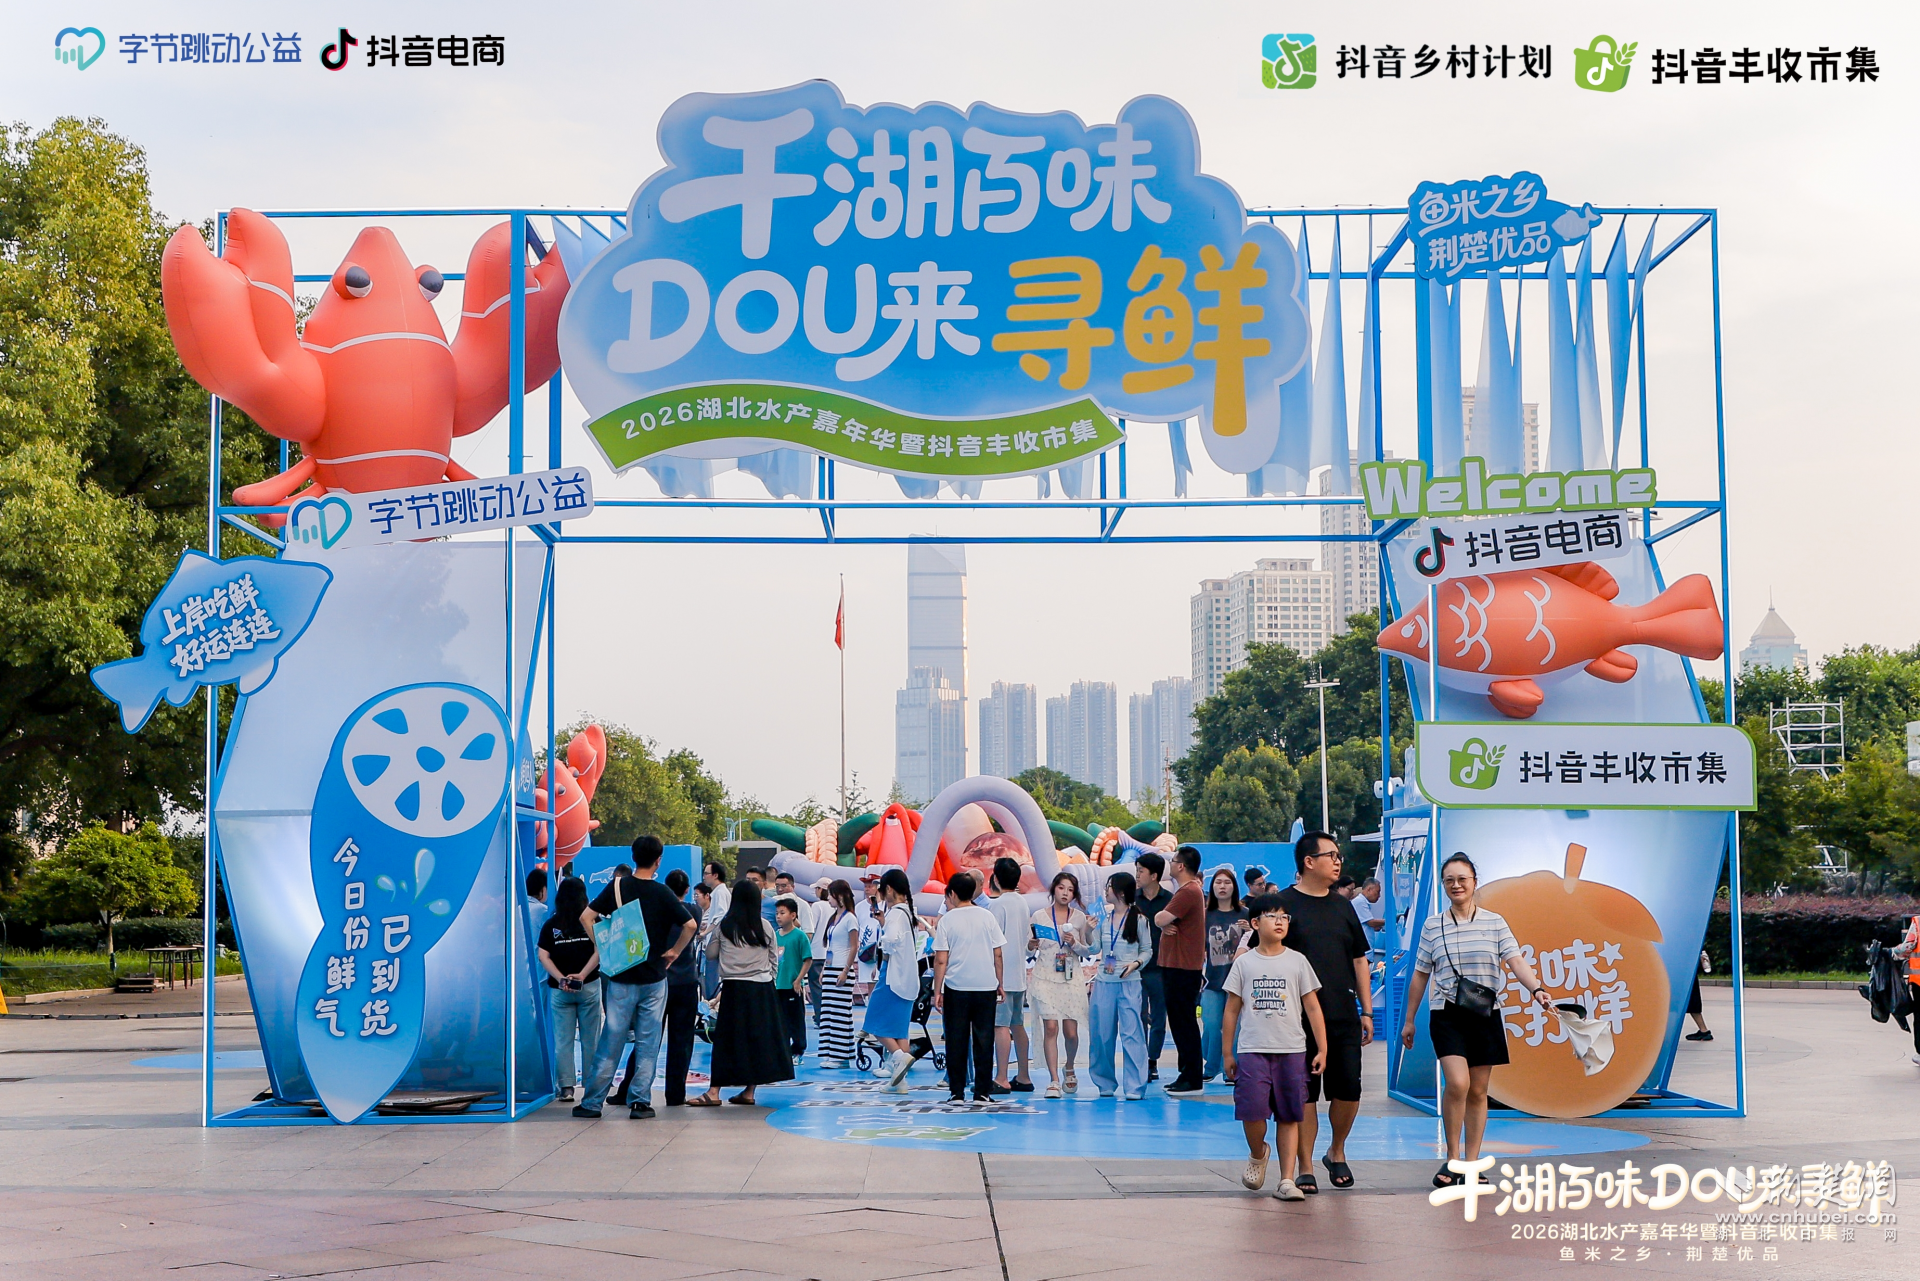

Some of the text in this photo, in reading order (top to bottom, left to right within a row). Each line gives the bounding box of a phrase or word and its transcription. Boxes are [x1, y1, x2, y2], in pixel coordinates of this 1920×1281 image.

[659, 108, 1172, 260] 千湖百味
[1418, 179, 1540, 237] 鱼米之乡
[1430, 221, 1552, 277] 荆楚优品
[621, 395, 1098, 459] 2026湖北水产嘉年华暨抖音丰收市集
[368, 473, 588, 535] 字节跳动公益
[1363, 460, 1655, 516] Welcome
[1465, 514, 1623, 567] 抖音电商
[161, 573, 260, 646] 上岸吃鲜
[169, 609, 281, 678] 好运连连
[1519, 750, 1728, 785] 抖音丰收市集
[315, 837, 371, 1037] 今日份鲜气
[360, 914, 412, 1037] 已到货
[1254, 980, 1285, 988] BOBDOG
[1500, 939, 1618, 1003] 味
